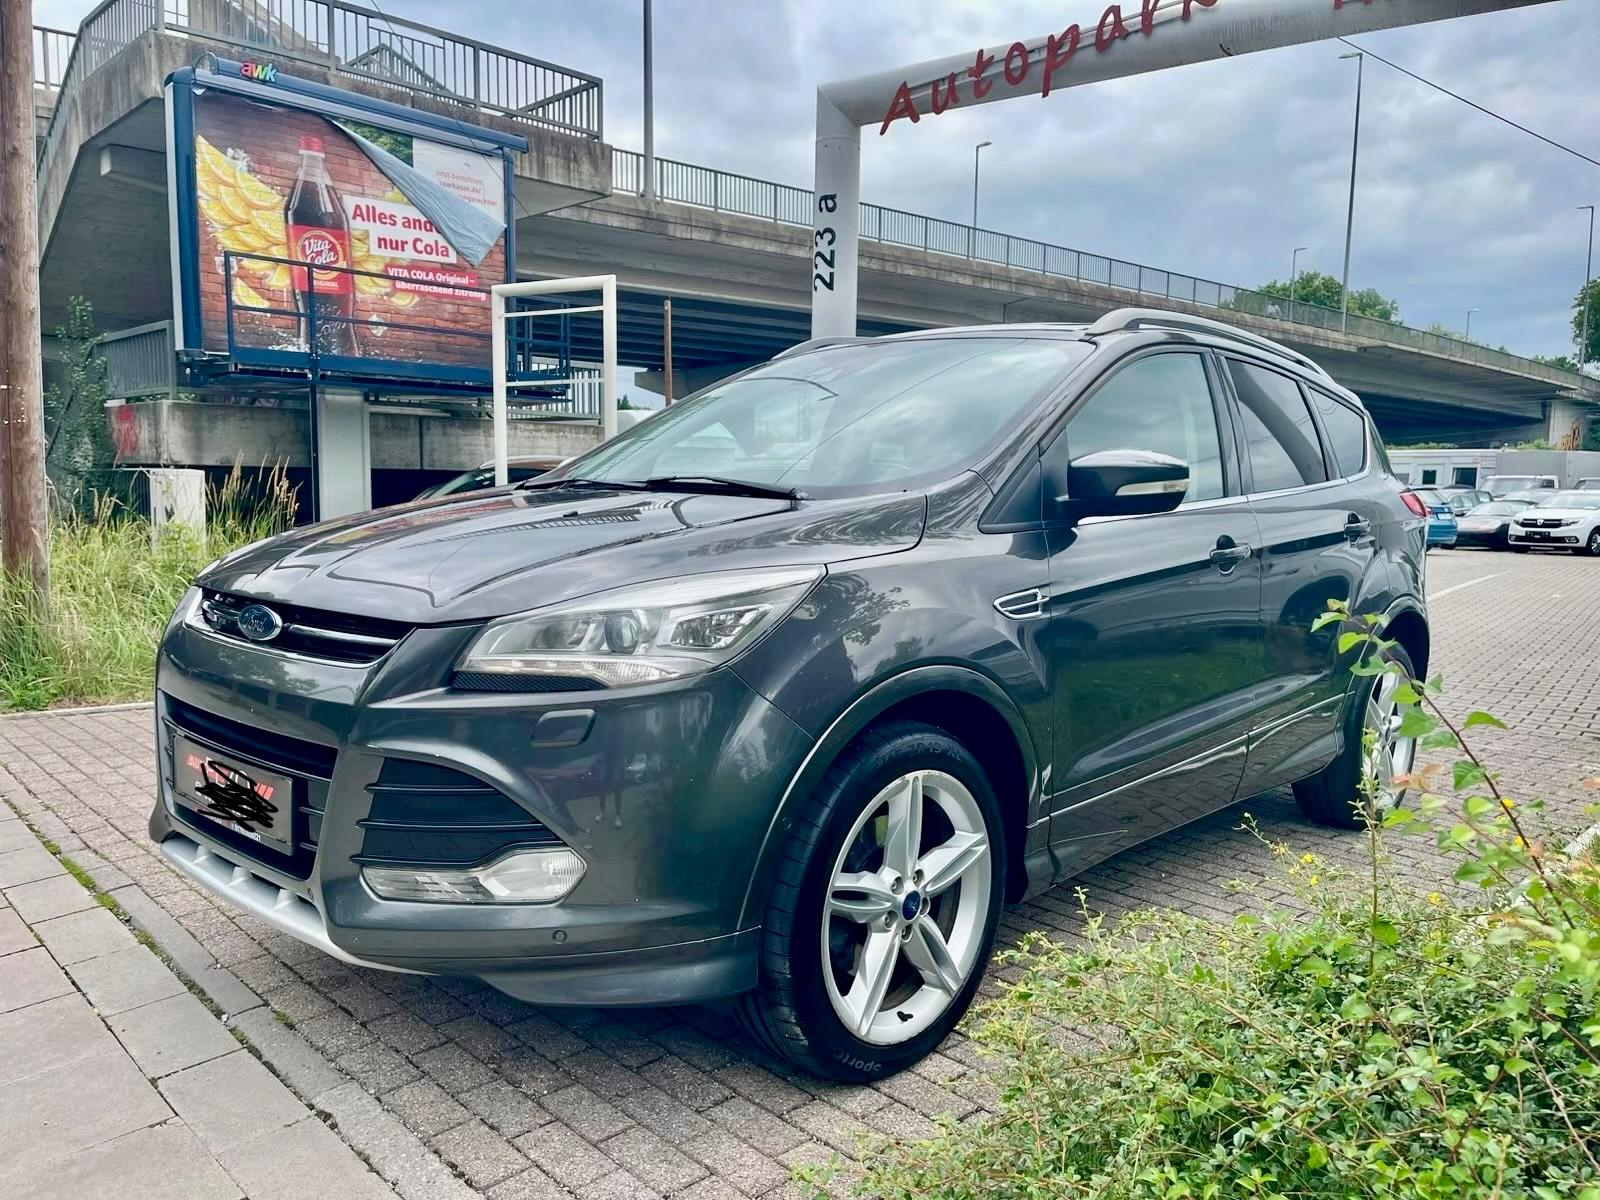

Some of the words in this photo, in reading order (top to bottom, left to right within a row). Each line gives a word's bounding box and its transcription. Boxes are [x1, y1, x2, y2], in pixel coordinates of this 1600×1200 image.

[240, 62, 277, 82] awk
[818, 193, 837, 213] a
[352, 204, 397, 226] Alles
[303, 237, 332, 255] Vita
[377, 236, 408, 252] nur
[412, 237, 450, 258] Cola
[306, 249, 338, 265] Cola
[813, 227, 836, 292] 223
[387, 267, 409, 278] VITA
[410, 269, 434, 282] COLA
[436, 273, 469, 286] Original
